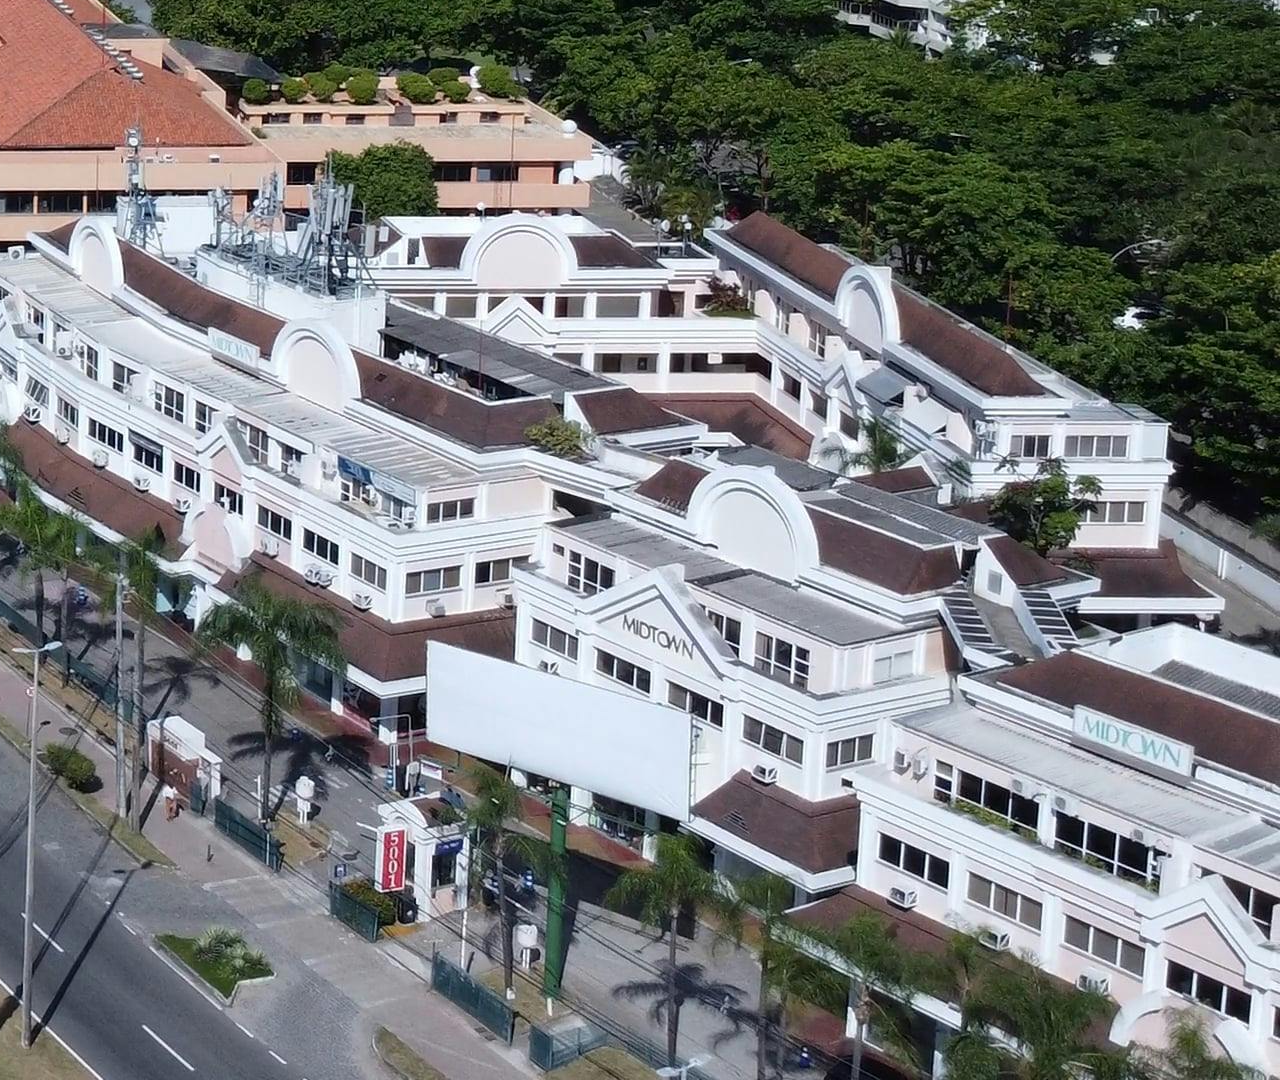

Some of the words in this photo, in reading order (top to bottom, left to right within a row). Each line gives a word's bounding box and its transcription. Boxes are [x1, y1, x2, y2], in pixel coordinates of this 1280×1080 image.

[212, 335, 255, 361] MIDTOWN
[623, 614, 696, 660] MIDTOWN
[1082, 716, 1182, 767] MIDTOWN
[388, 831, 400, 888] 5001
